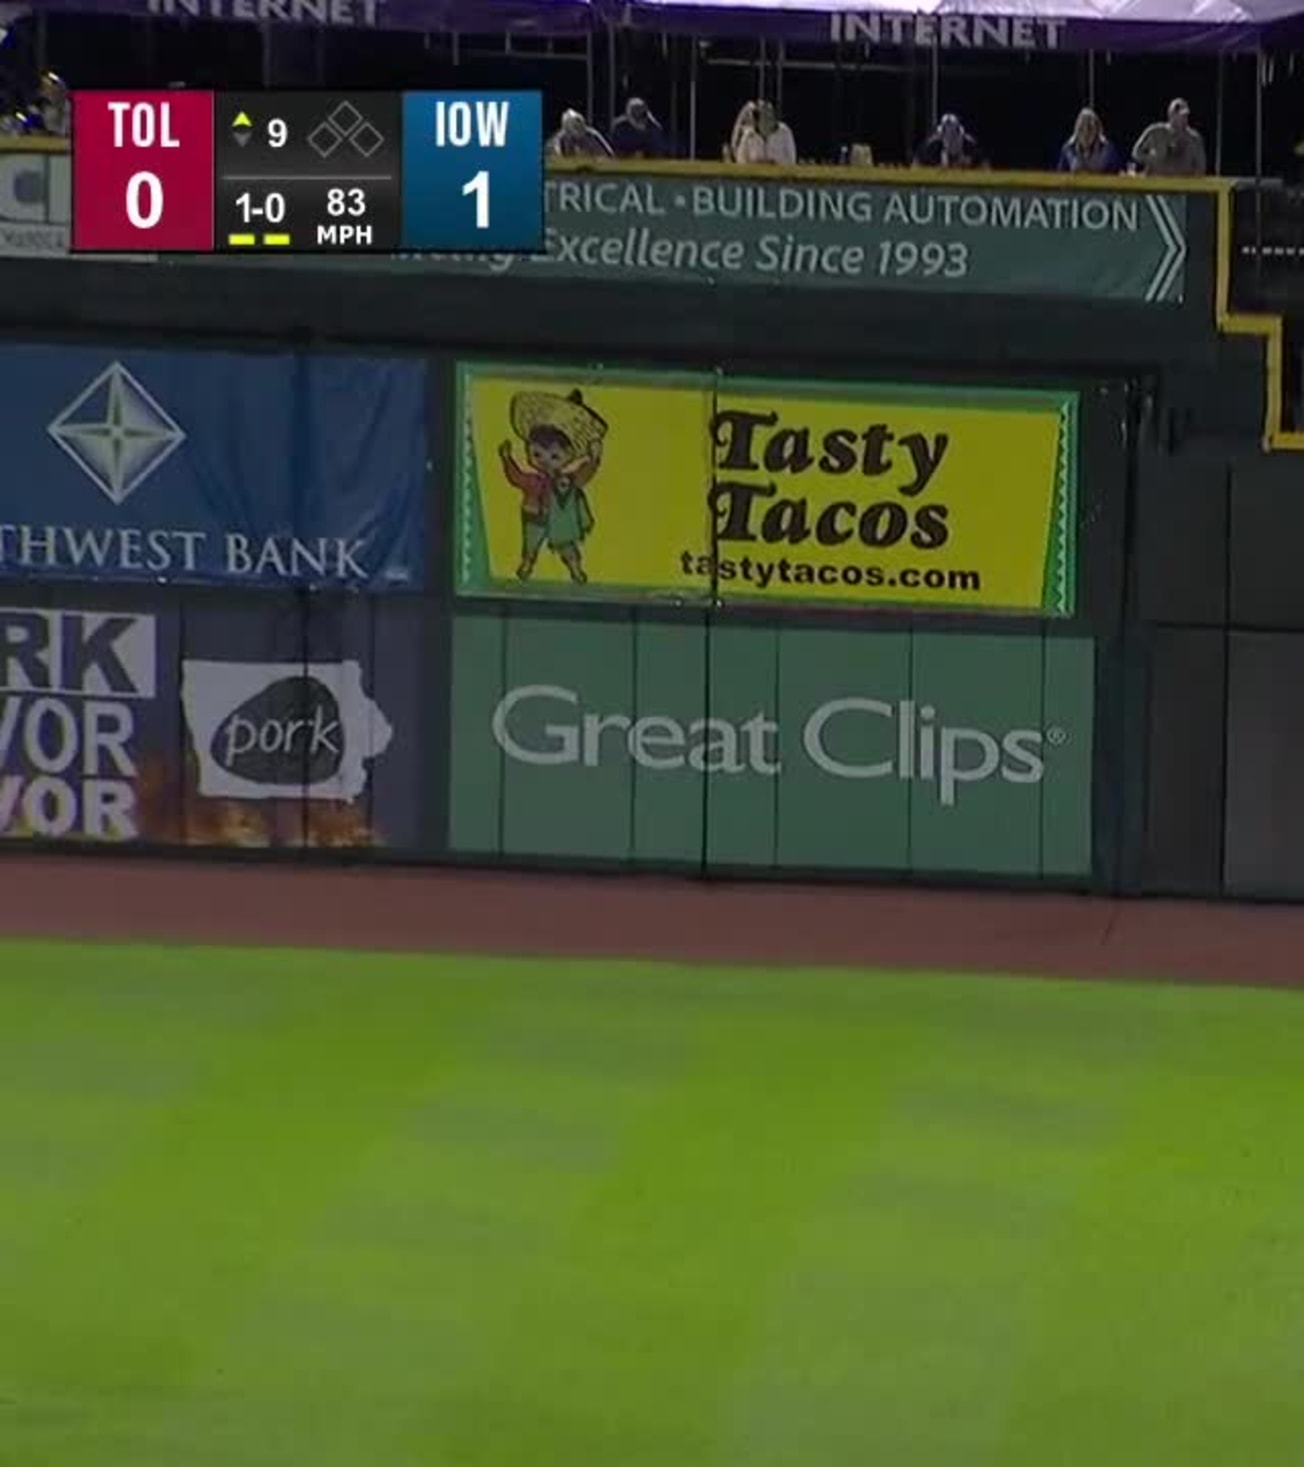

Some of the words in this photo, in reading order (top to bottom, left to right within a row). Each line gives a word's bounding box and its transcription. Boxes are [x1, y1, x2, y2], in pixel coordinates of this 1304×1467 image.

[829, 13, 1066, 49] INTERNET
[692, 185, 872, 221] BUILDING
[884, 193, 1139, 232] AUTOMATION
[755, 234, 865, 275] Since
[879, 241, 969, 278] 1993
[709, 410, 949, 497] Tasty
[707, 481, 950, 549] Tacos
[224, 532, 369, 579] BANK
[681, 551, 981, 590] tastytacos.com
[224, 704, 340, 767] pork
[491, 684, 782, 774] Great
